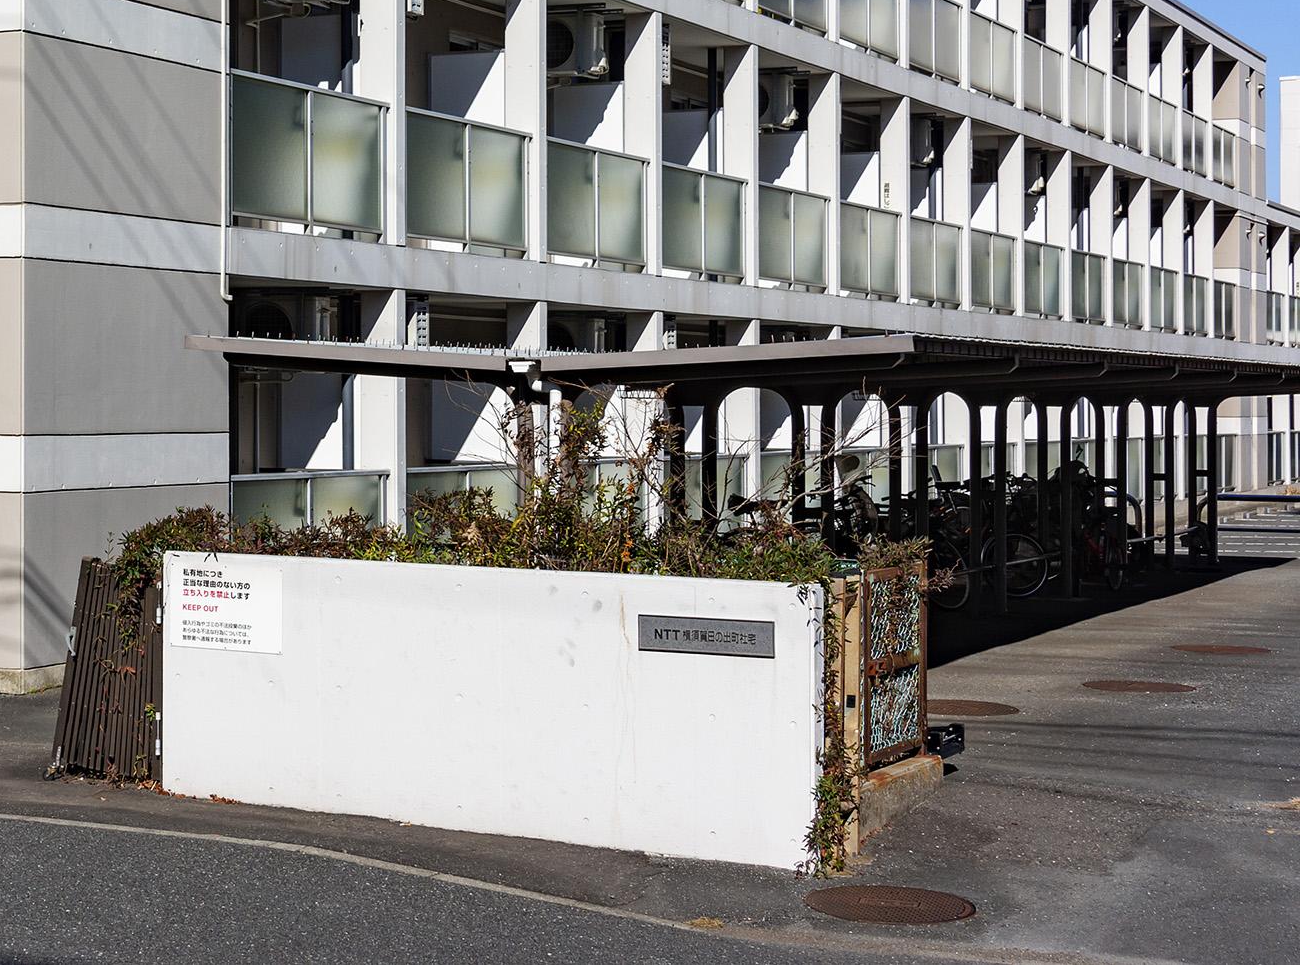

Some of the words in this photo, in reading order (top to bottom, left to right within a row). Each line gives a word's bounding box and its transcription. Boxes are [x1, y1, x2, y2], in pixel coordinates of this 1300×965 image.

[183, 568, 223, 578] 私有地につき
[182, 578, 251, 590] 正当な理由のない方の
[182, 588, 251, 600] 立ち入りを禁止します
[182, 603, 202, 611] KEEP
[654, 628, 681, 641] NTT
[682, 629, 757, 646] 横須賀日の出町社宅
